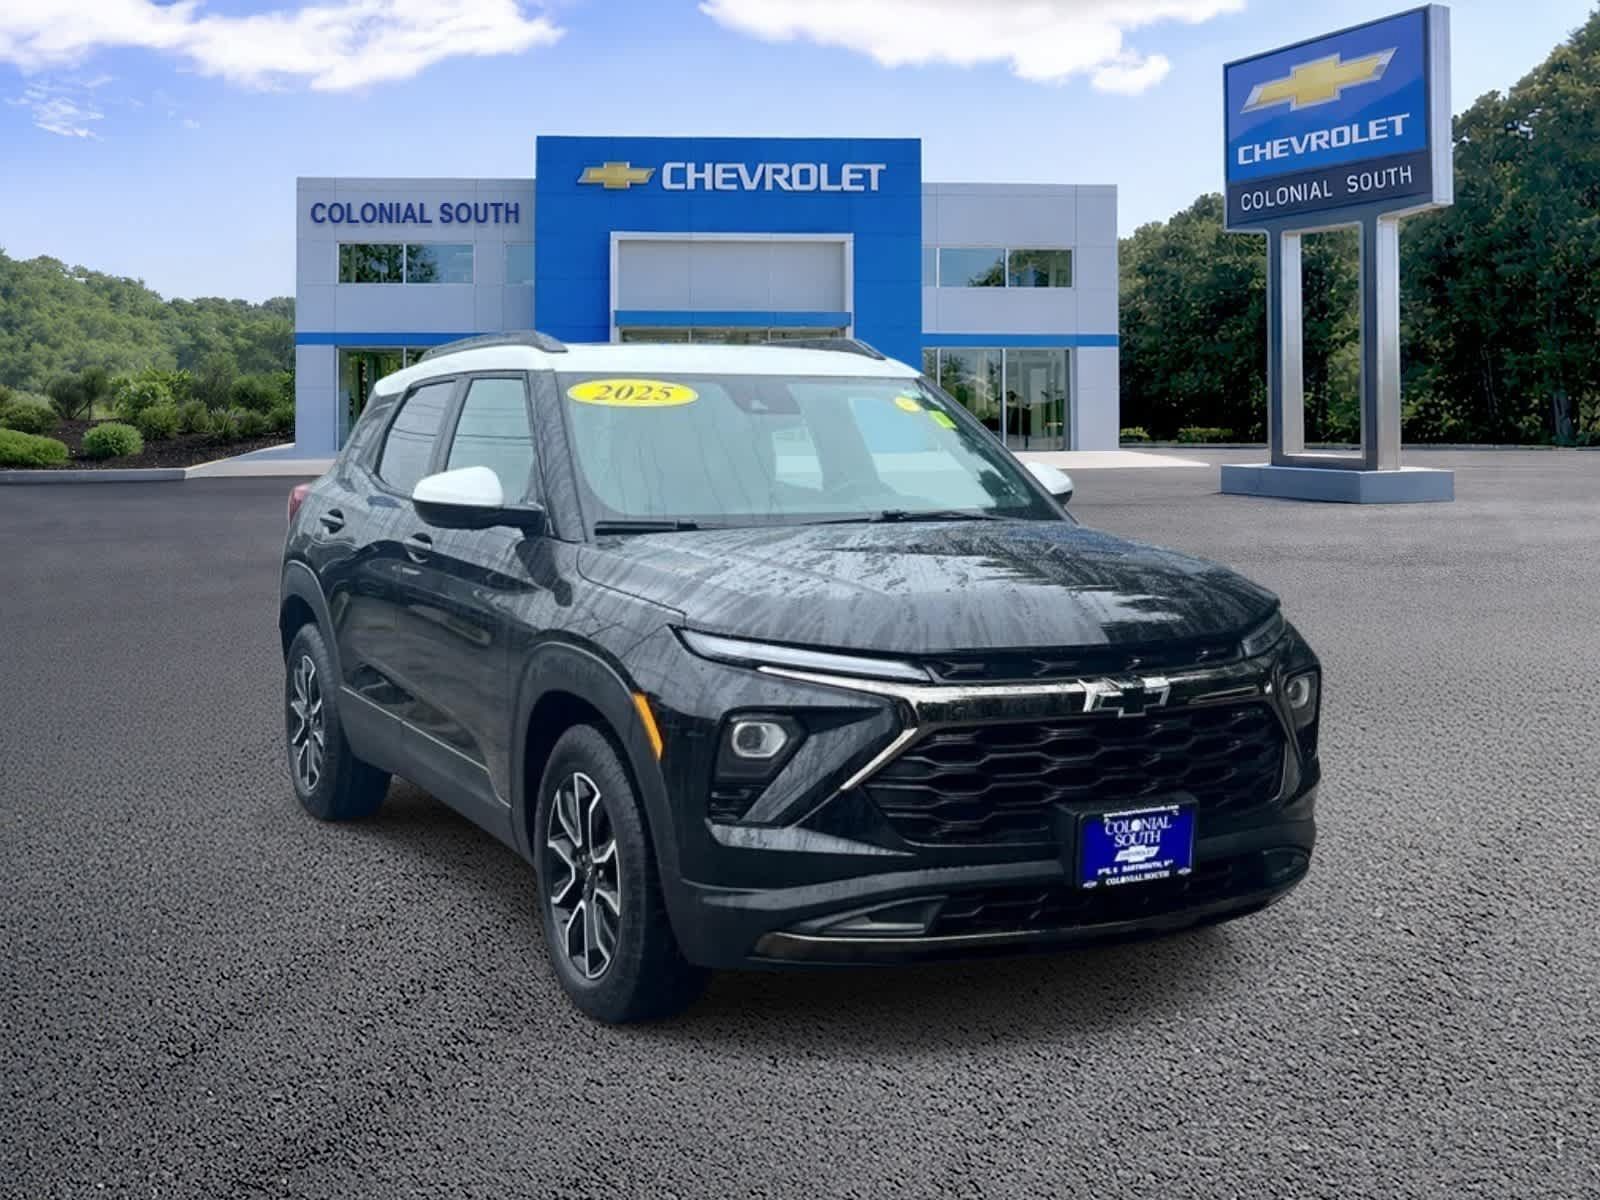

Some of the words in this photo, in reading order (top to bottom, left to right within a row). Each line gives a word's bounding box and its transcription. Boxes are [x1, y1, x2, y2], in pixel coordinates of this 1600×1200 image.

[1238, 113, 1410, 165] CHEVROLET
[662, 162, 887, 191] CHEVROLET
[1241, 180, 1333, 211] COLONIAL
[1346, 165, 1413, 193] SOUTH
[310, 202, 432, 224] COLONIAL
[439, 202, 520, 224] SOUTH
[592, 385, 675, 400] 2025
[1105, 816, 1172, 835] COLONIAL
[1114, 830, 1161, 847] SOUTH
